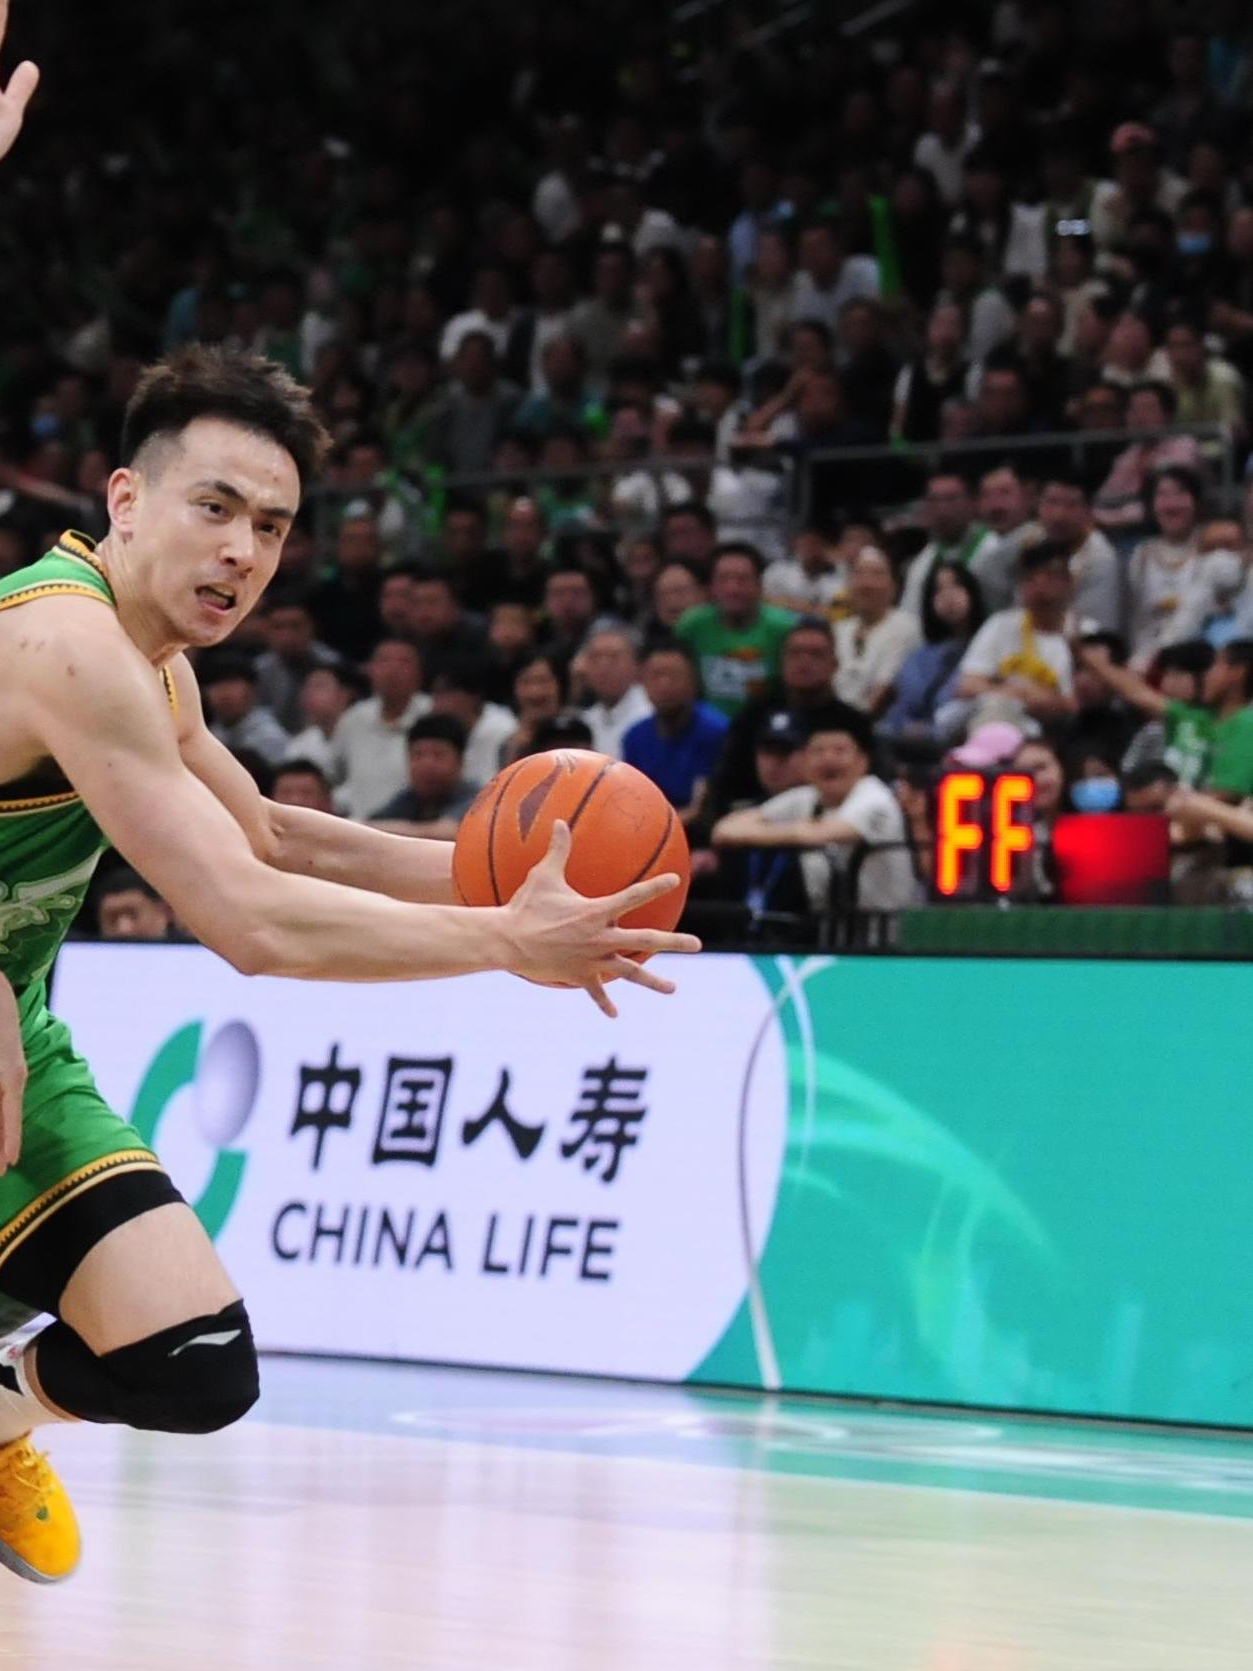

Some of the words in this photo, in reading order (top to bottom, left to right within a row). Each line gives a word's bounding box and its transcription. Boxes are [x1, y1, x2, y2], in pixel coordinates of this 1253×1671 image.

[934, 772, 1035, 896] FF
[290, 1042, 649, 1184] 中国人寿
[271, 1201, 455, 1272] CHINA
[481, 1212, 621, 1283] LIFE
